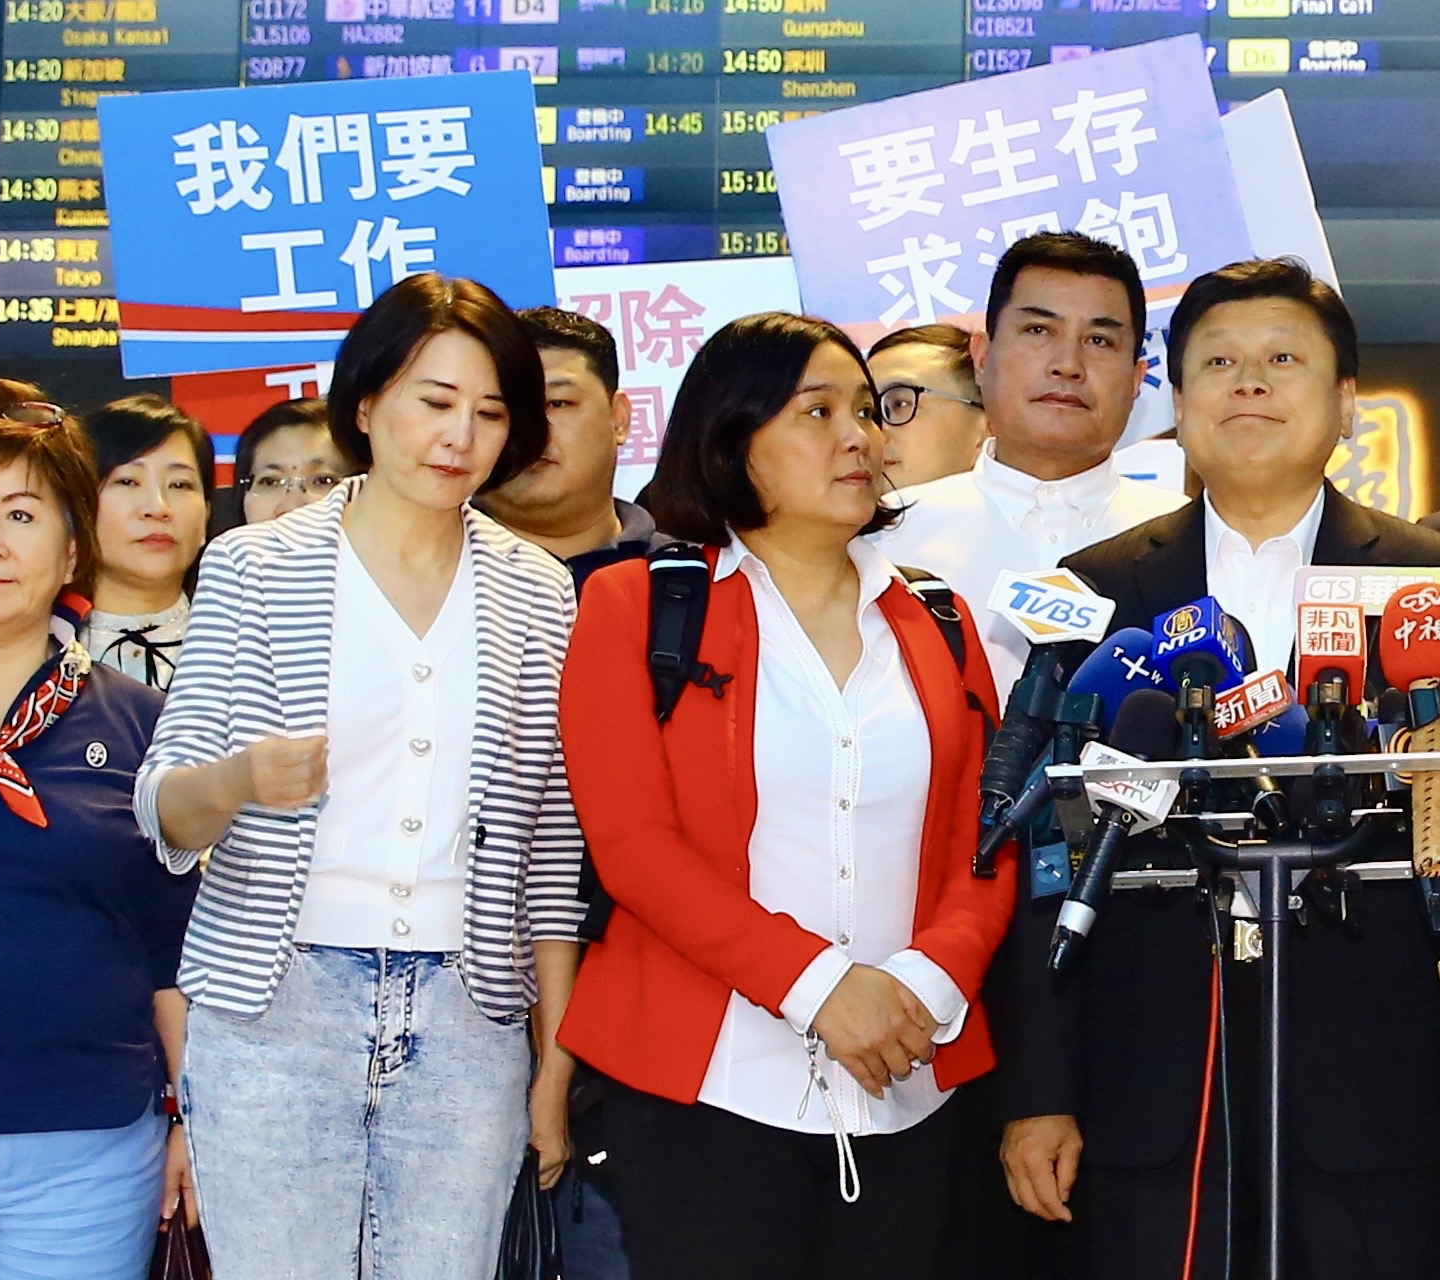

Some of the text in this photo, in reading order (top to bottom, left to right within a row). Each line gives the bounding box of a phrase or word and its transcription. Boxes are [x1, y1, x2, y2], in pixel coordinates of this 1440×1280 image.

[781, 19, 865, 38] Guangzhou
[4, 57, 62, 83] 14:20
[647, 51, 705, 75] 14:20
[722, 49, 782, 74] 14:50
[1243, 49, 1277, 67] D6
[782, 79, 857, 98] Shenzhen
[1, 118, 59, 143] 14:30
[566, 125, 632, 143] Boarding
[645, 112, 703, 135] 14:45
[722, 110, 780, 134] 15:05
[171, 105, 477, 217] 我們要
[838, 87, 1158, 233] 要生存
[0, 178, 58, 202] 14:30
[565, 184, 631, 202] Boarding
[564, 246, 630, 264] Boarding
[720, 231, 779, 255] 15:15
[238, 214, 439, 316] 工作
[55, 267, 103, 288] Tokyo
[1307, 579, 1352, 601] CTS
[1007, 580, 1098, 630] TVBS
[1306, 610, 1355, 628] 非凡
[1157, 626, 1208, 655] NTD
[1305, 631, 1356, 653] 新聞
[1213, 674, 1284, 729] 新聞
